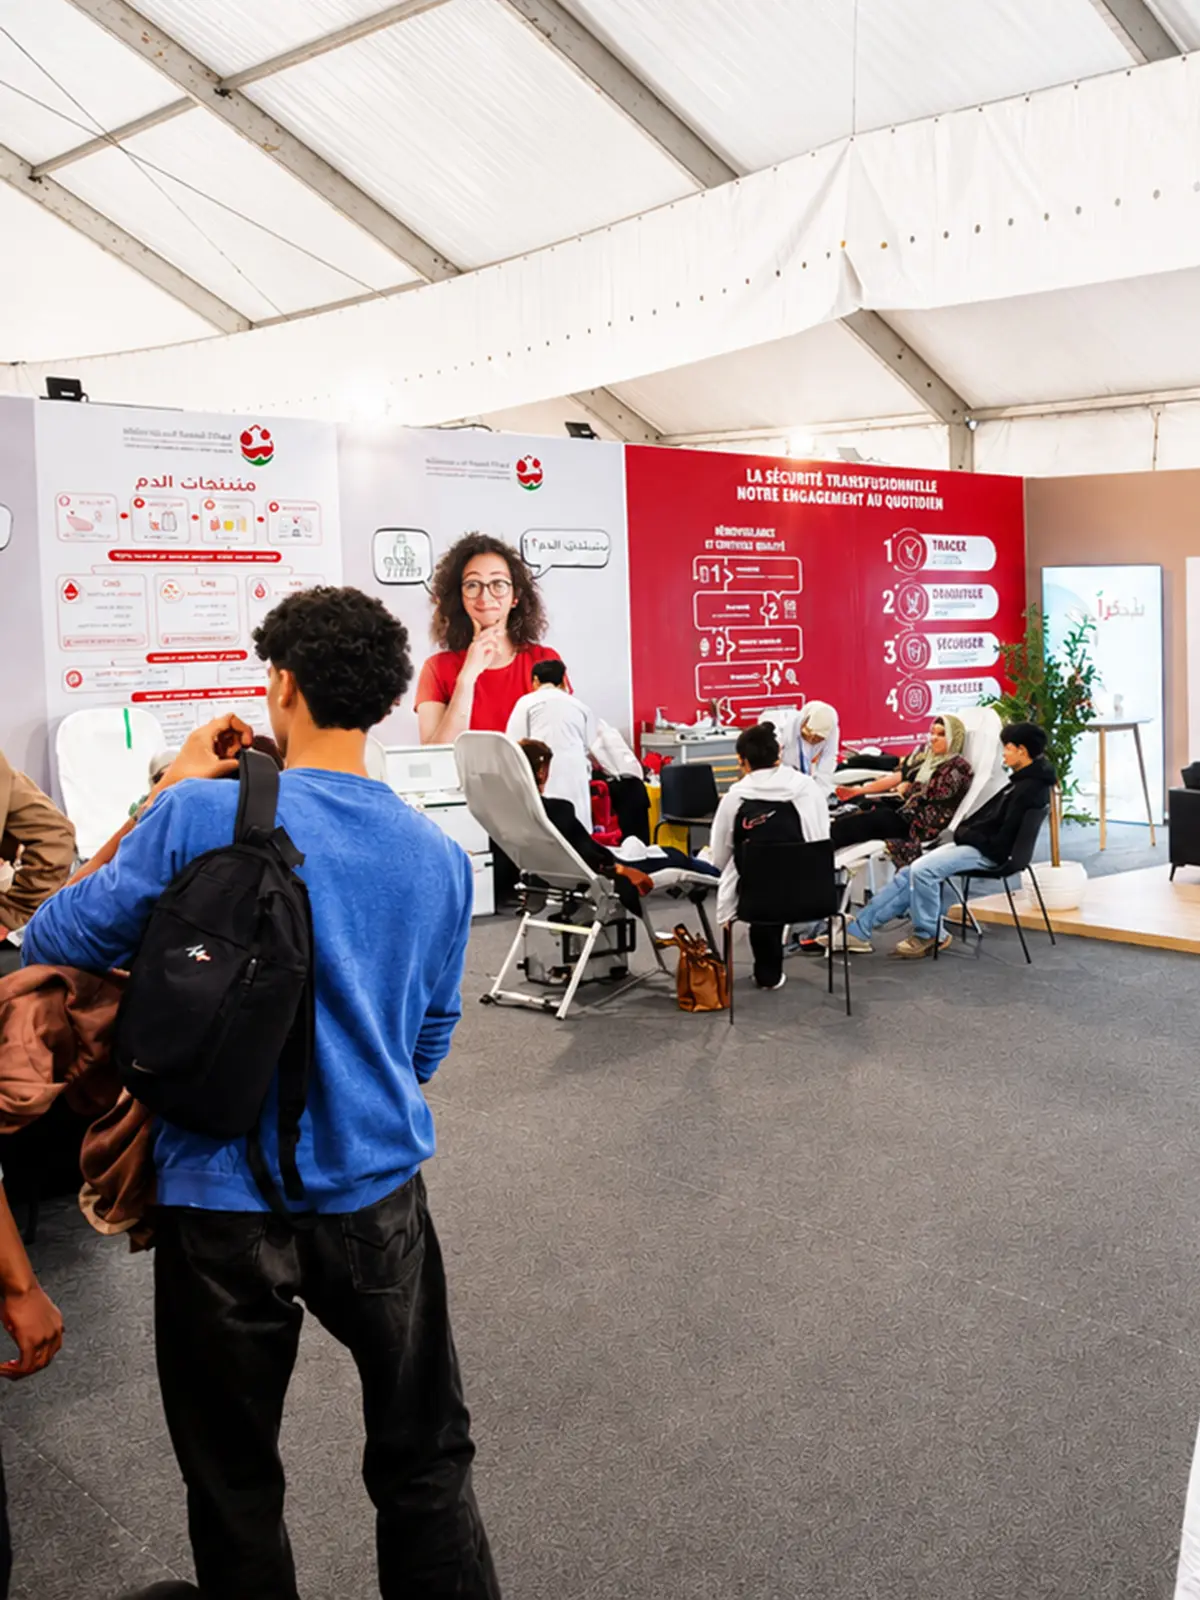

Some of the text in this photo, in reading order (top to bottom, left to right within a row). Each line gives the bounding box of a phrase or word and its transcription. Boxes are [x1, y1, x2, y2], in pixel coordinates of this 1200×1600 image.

[135, 475, 173, 491] الدم
[746, 468, 763, 483] LA
[765, 467, 823, 487] SÉCURITÉ
[737, 486, 944, 510] NOTRE ENGAGEMENT AU QUOTIDIEN
[882, 590, 895, 614] 2
[884, 640, 897, 664] 3
